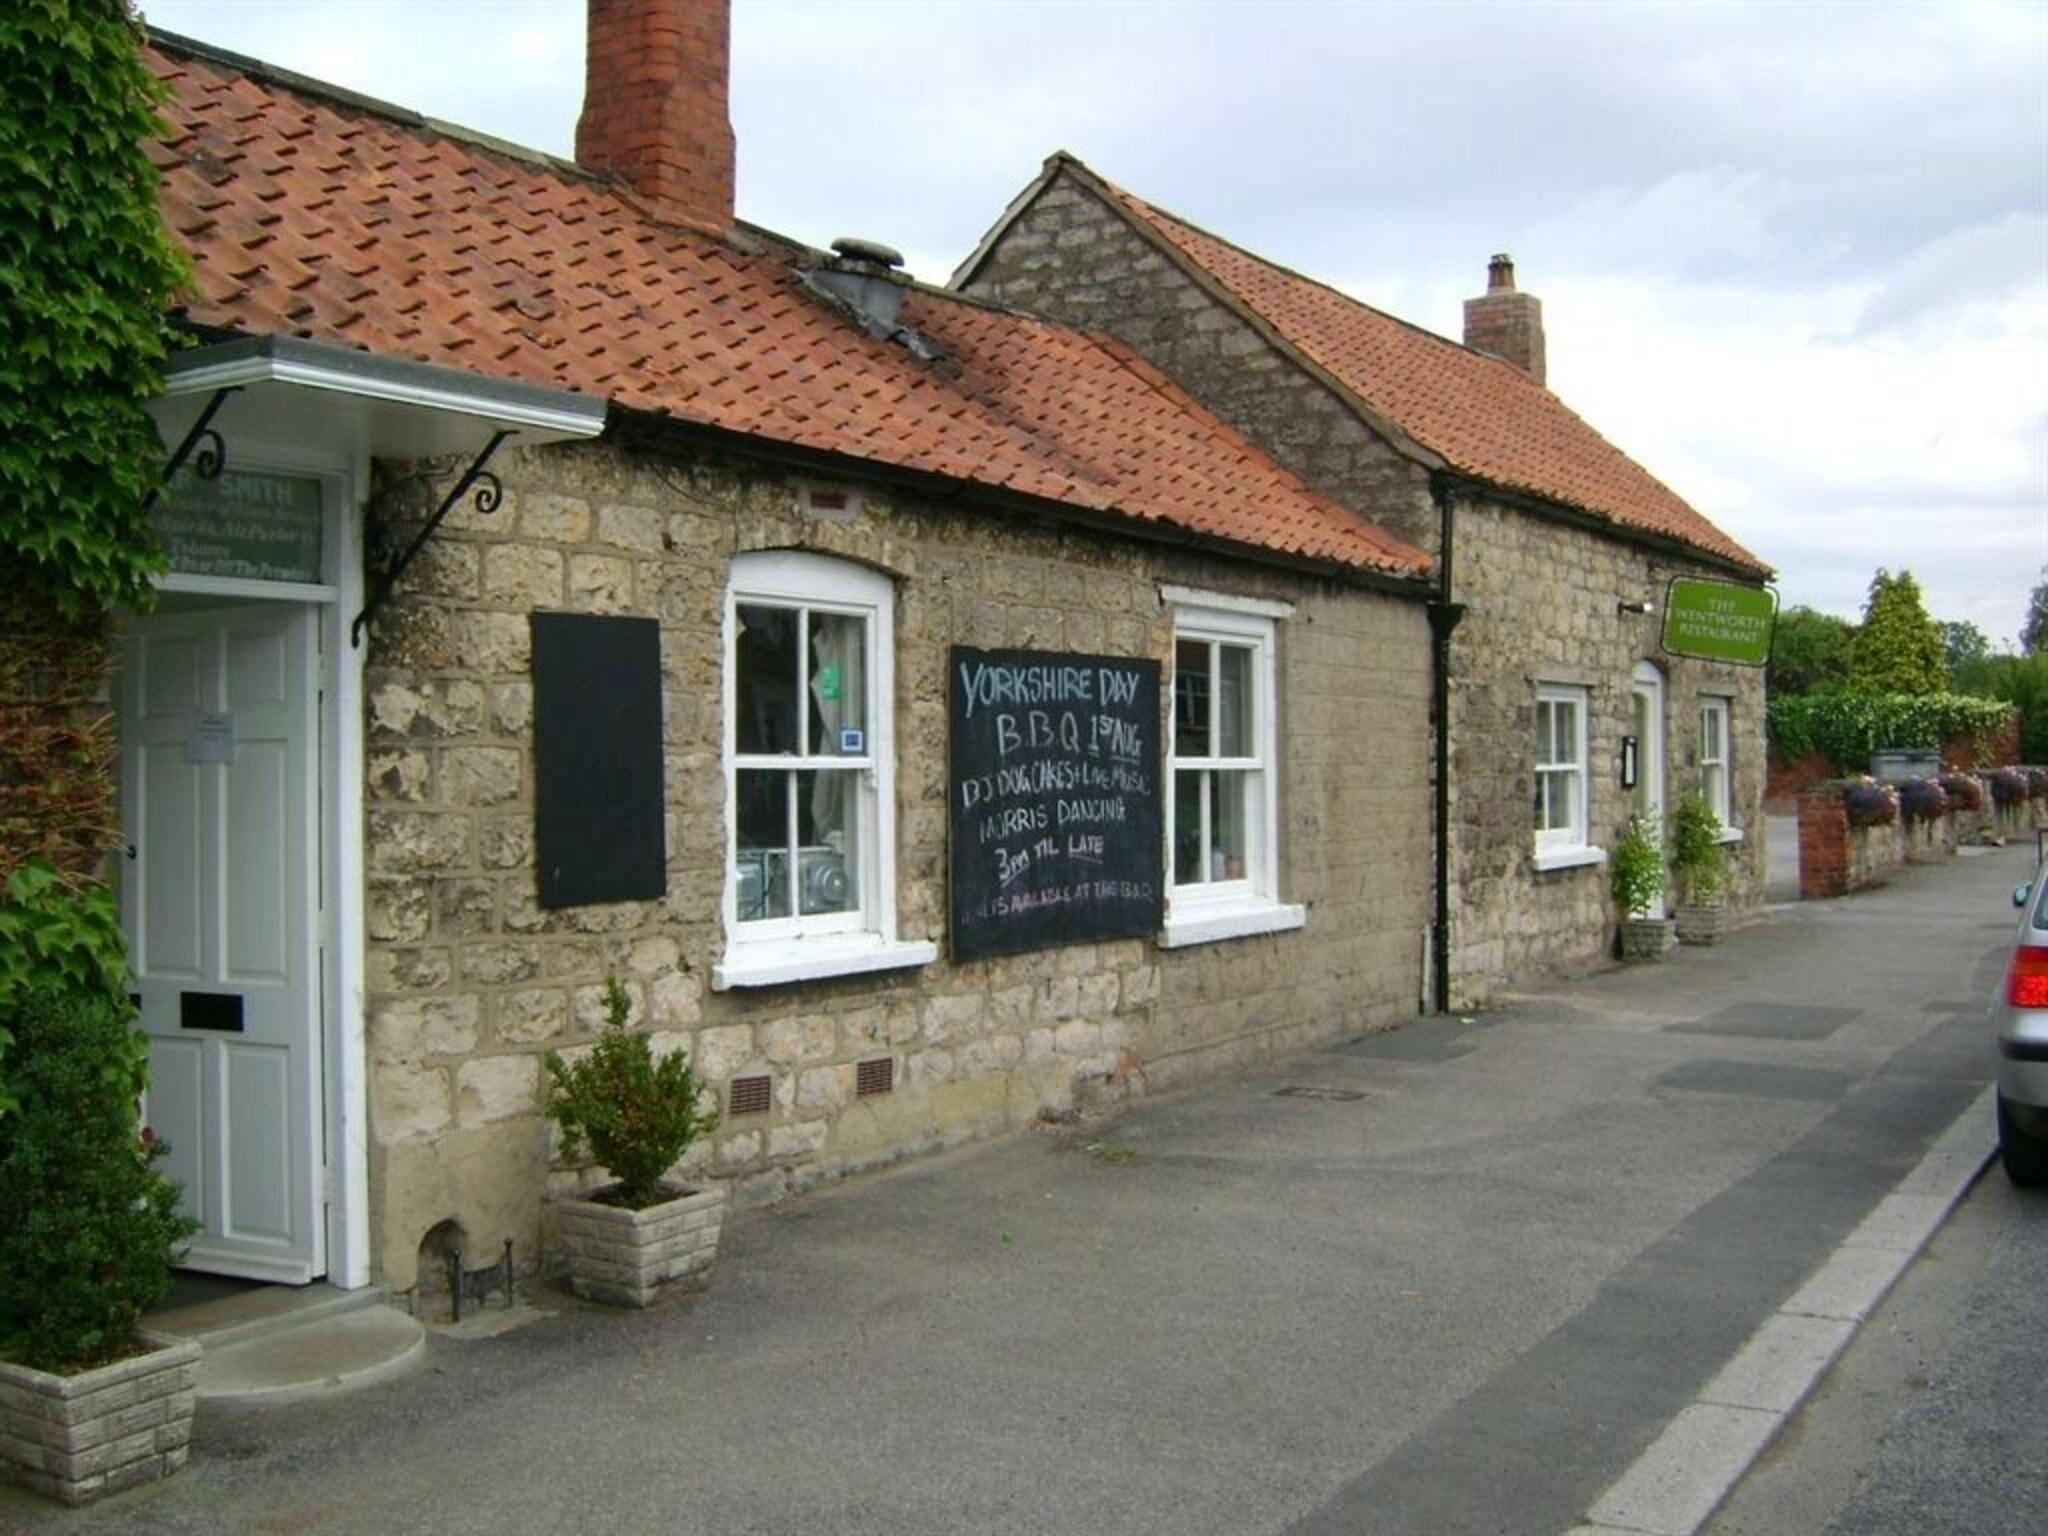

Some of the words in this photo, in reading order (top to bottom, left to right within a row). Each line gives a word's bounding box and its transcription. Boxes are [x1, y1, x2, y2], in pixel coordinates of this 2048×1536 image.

[1709, 597, 1737, 613] THE
[1675, 607, 1766, 630] WENTWORTH
[1679, 622, 1759, 643] RESTAURANT
[959, 661, 1094, 718] YORKSHIRE
[1099, 668, 1140, 705] DAY
[961, 774, 994, 808] DJ
[1057, 798, 1127, 825] DANCING
[1068, 833, 1104, 855] LATE
